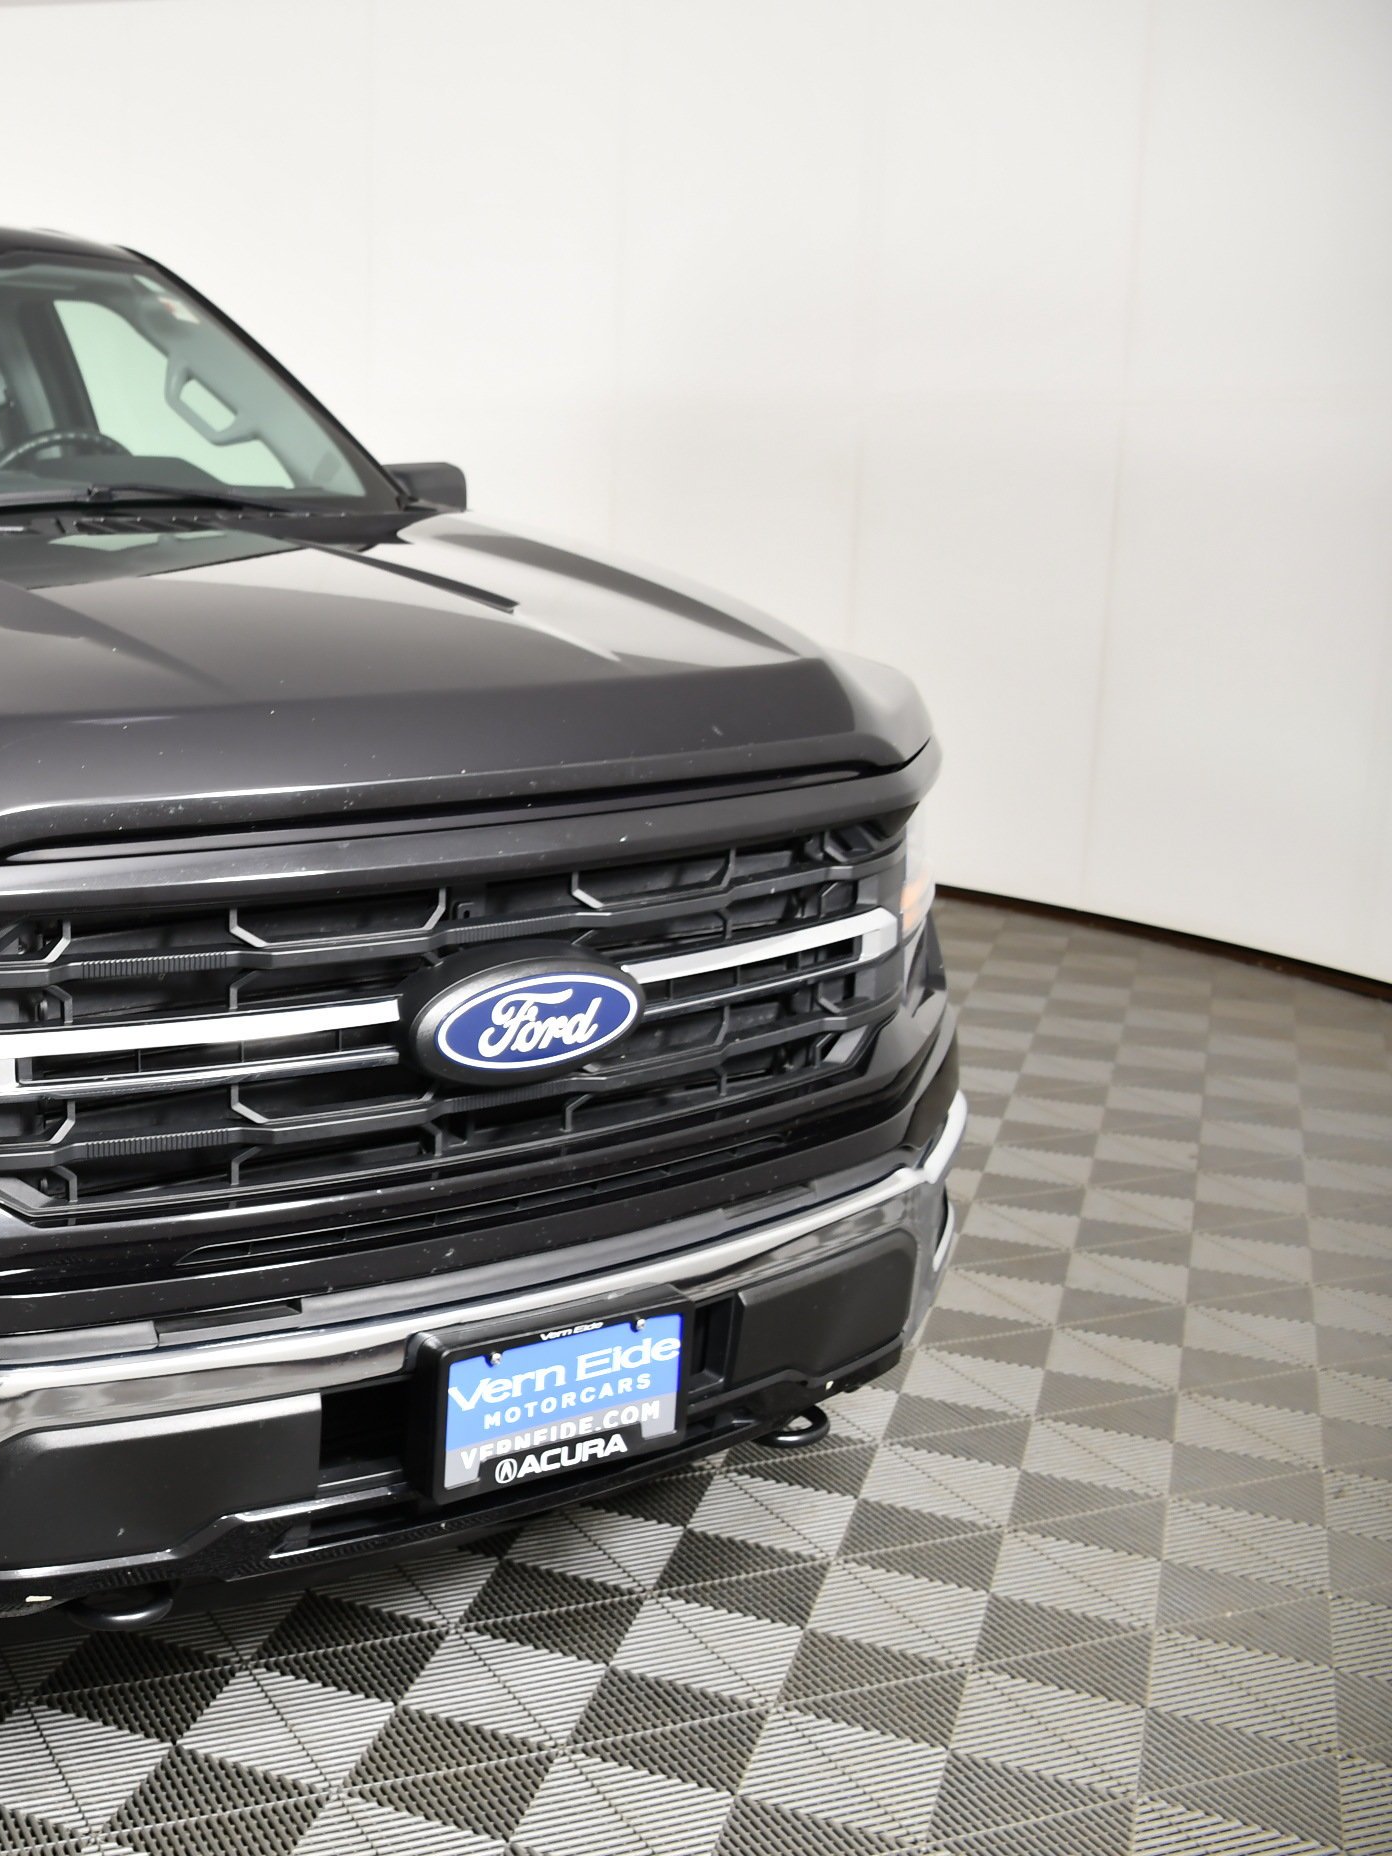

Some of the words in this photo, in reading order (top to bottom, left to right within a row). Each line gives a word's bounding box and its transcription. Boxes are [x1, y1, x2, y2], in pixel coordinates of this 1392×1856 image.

[478, 988, 603, 1058] Ford
[539, 1328, 573, 1341] Vern
[573, 1321, 604, 1334] Eide
[448, 1363, 566, 1412] Vern
[575, 1336, 682, 1382] Eide
[483, 1373, 652, 1430] MOTORCARS
[516, 1433, 628, 1479] ACURA
